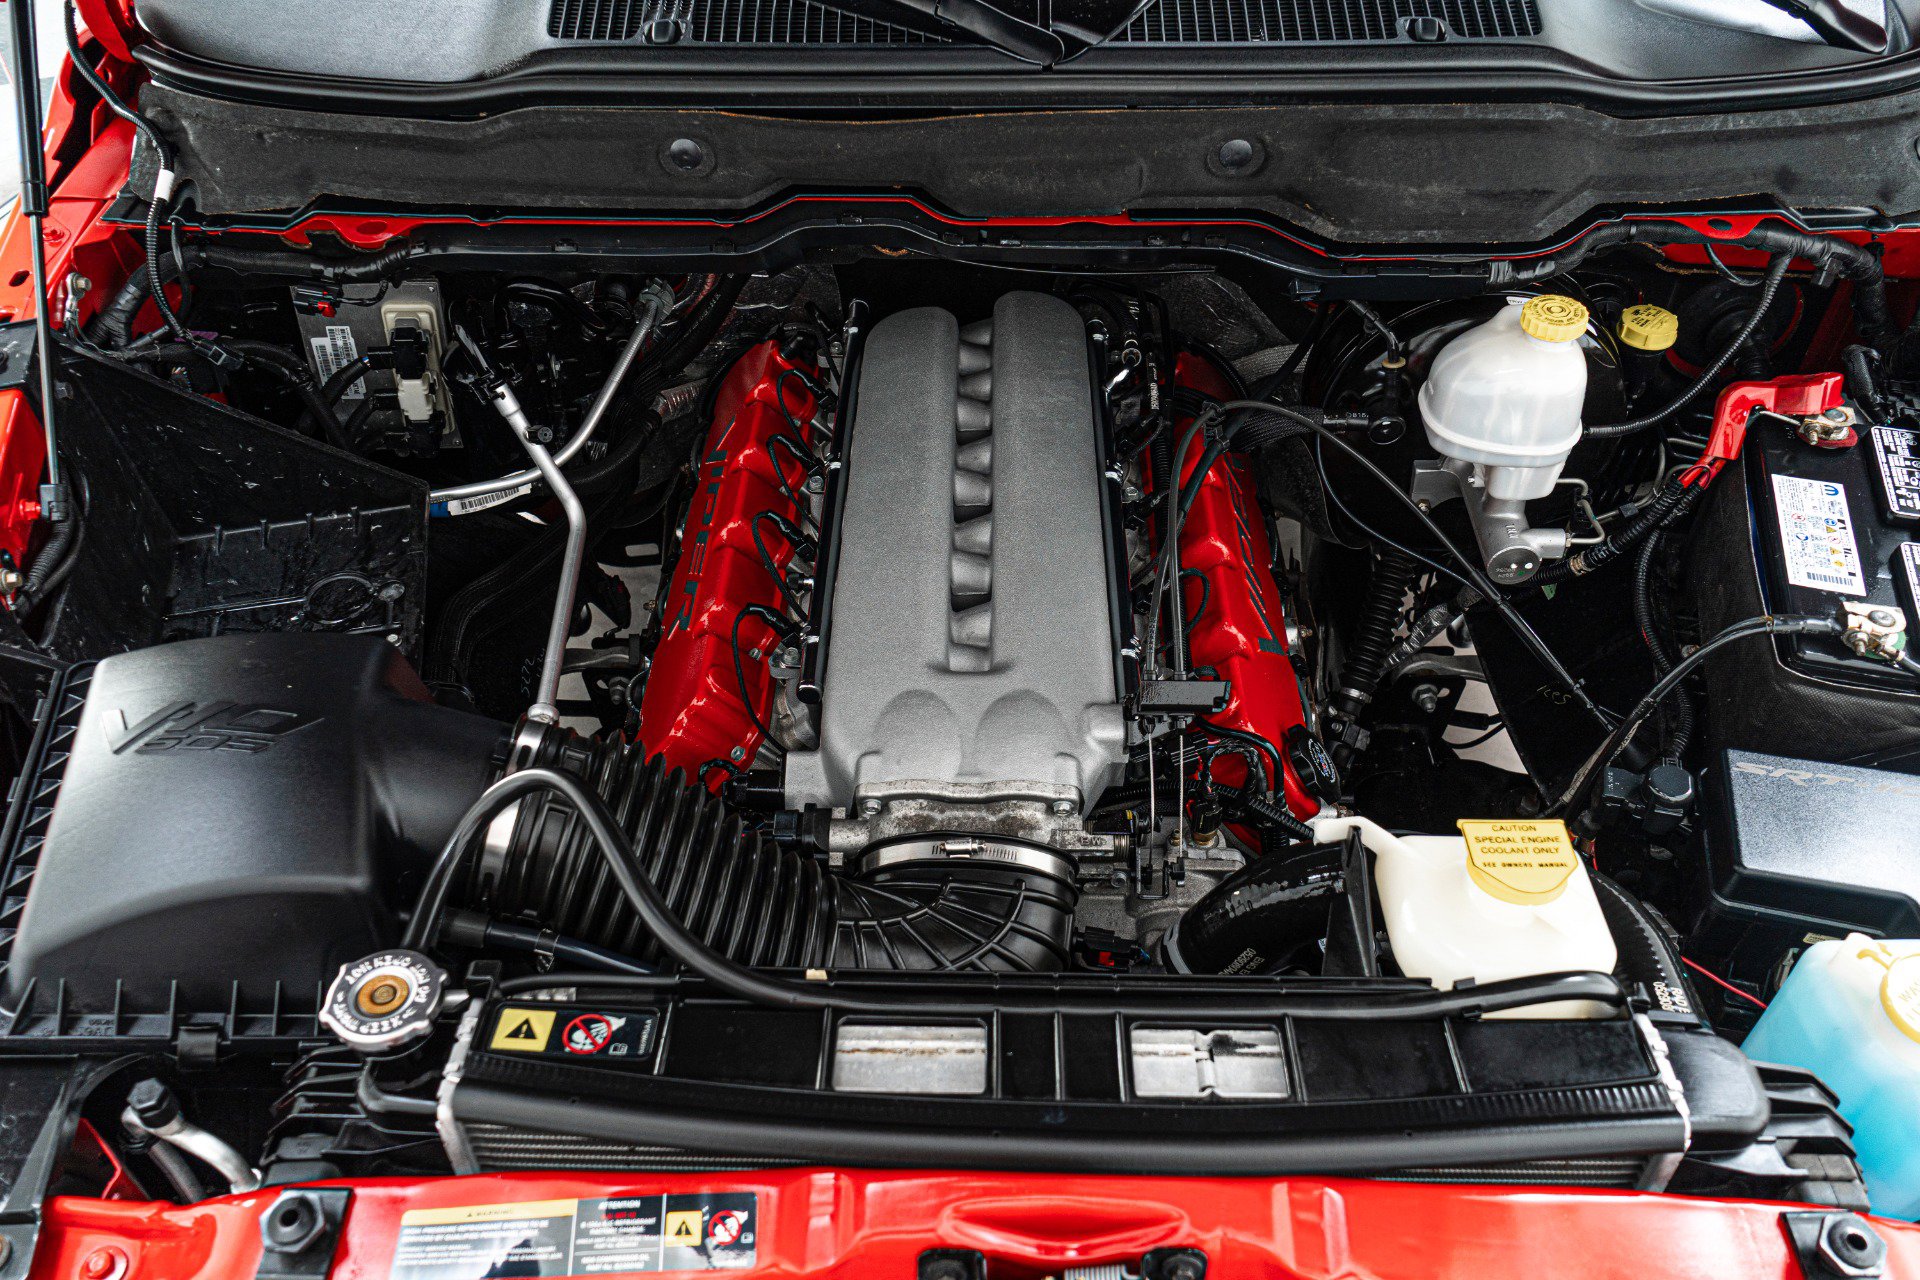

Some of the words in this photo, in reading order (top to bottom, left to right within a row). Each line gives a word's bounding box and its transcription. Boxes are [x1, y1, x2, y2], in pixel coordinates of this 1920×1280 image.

[668, 413, 737, 641] VIPER
[1491, 824, 1537, 832] CAUTION
[1474, 836, 1520, 844] SPECIAL
[1521, 835, 1561, 843] ENGINE
[1480, 846, 1529, 854] COOLANT
[1532, 846, 1560, 854] ONLY
